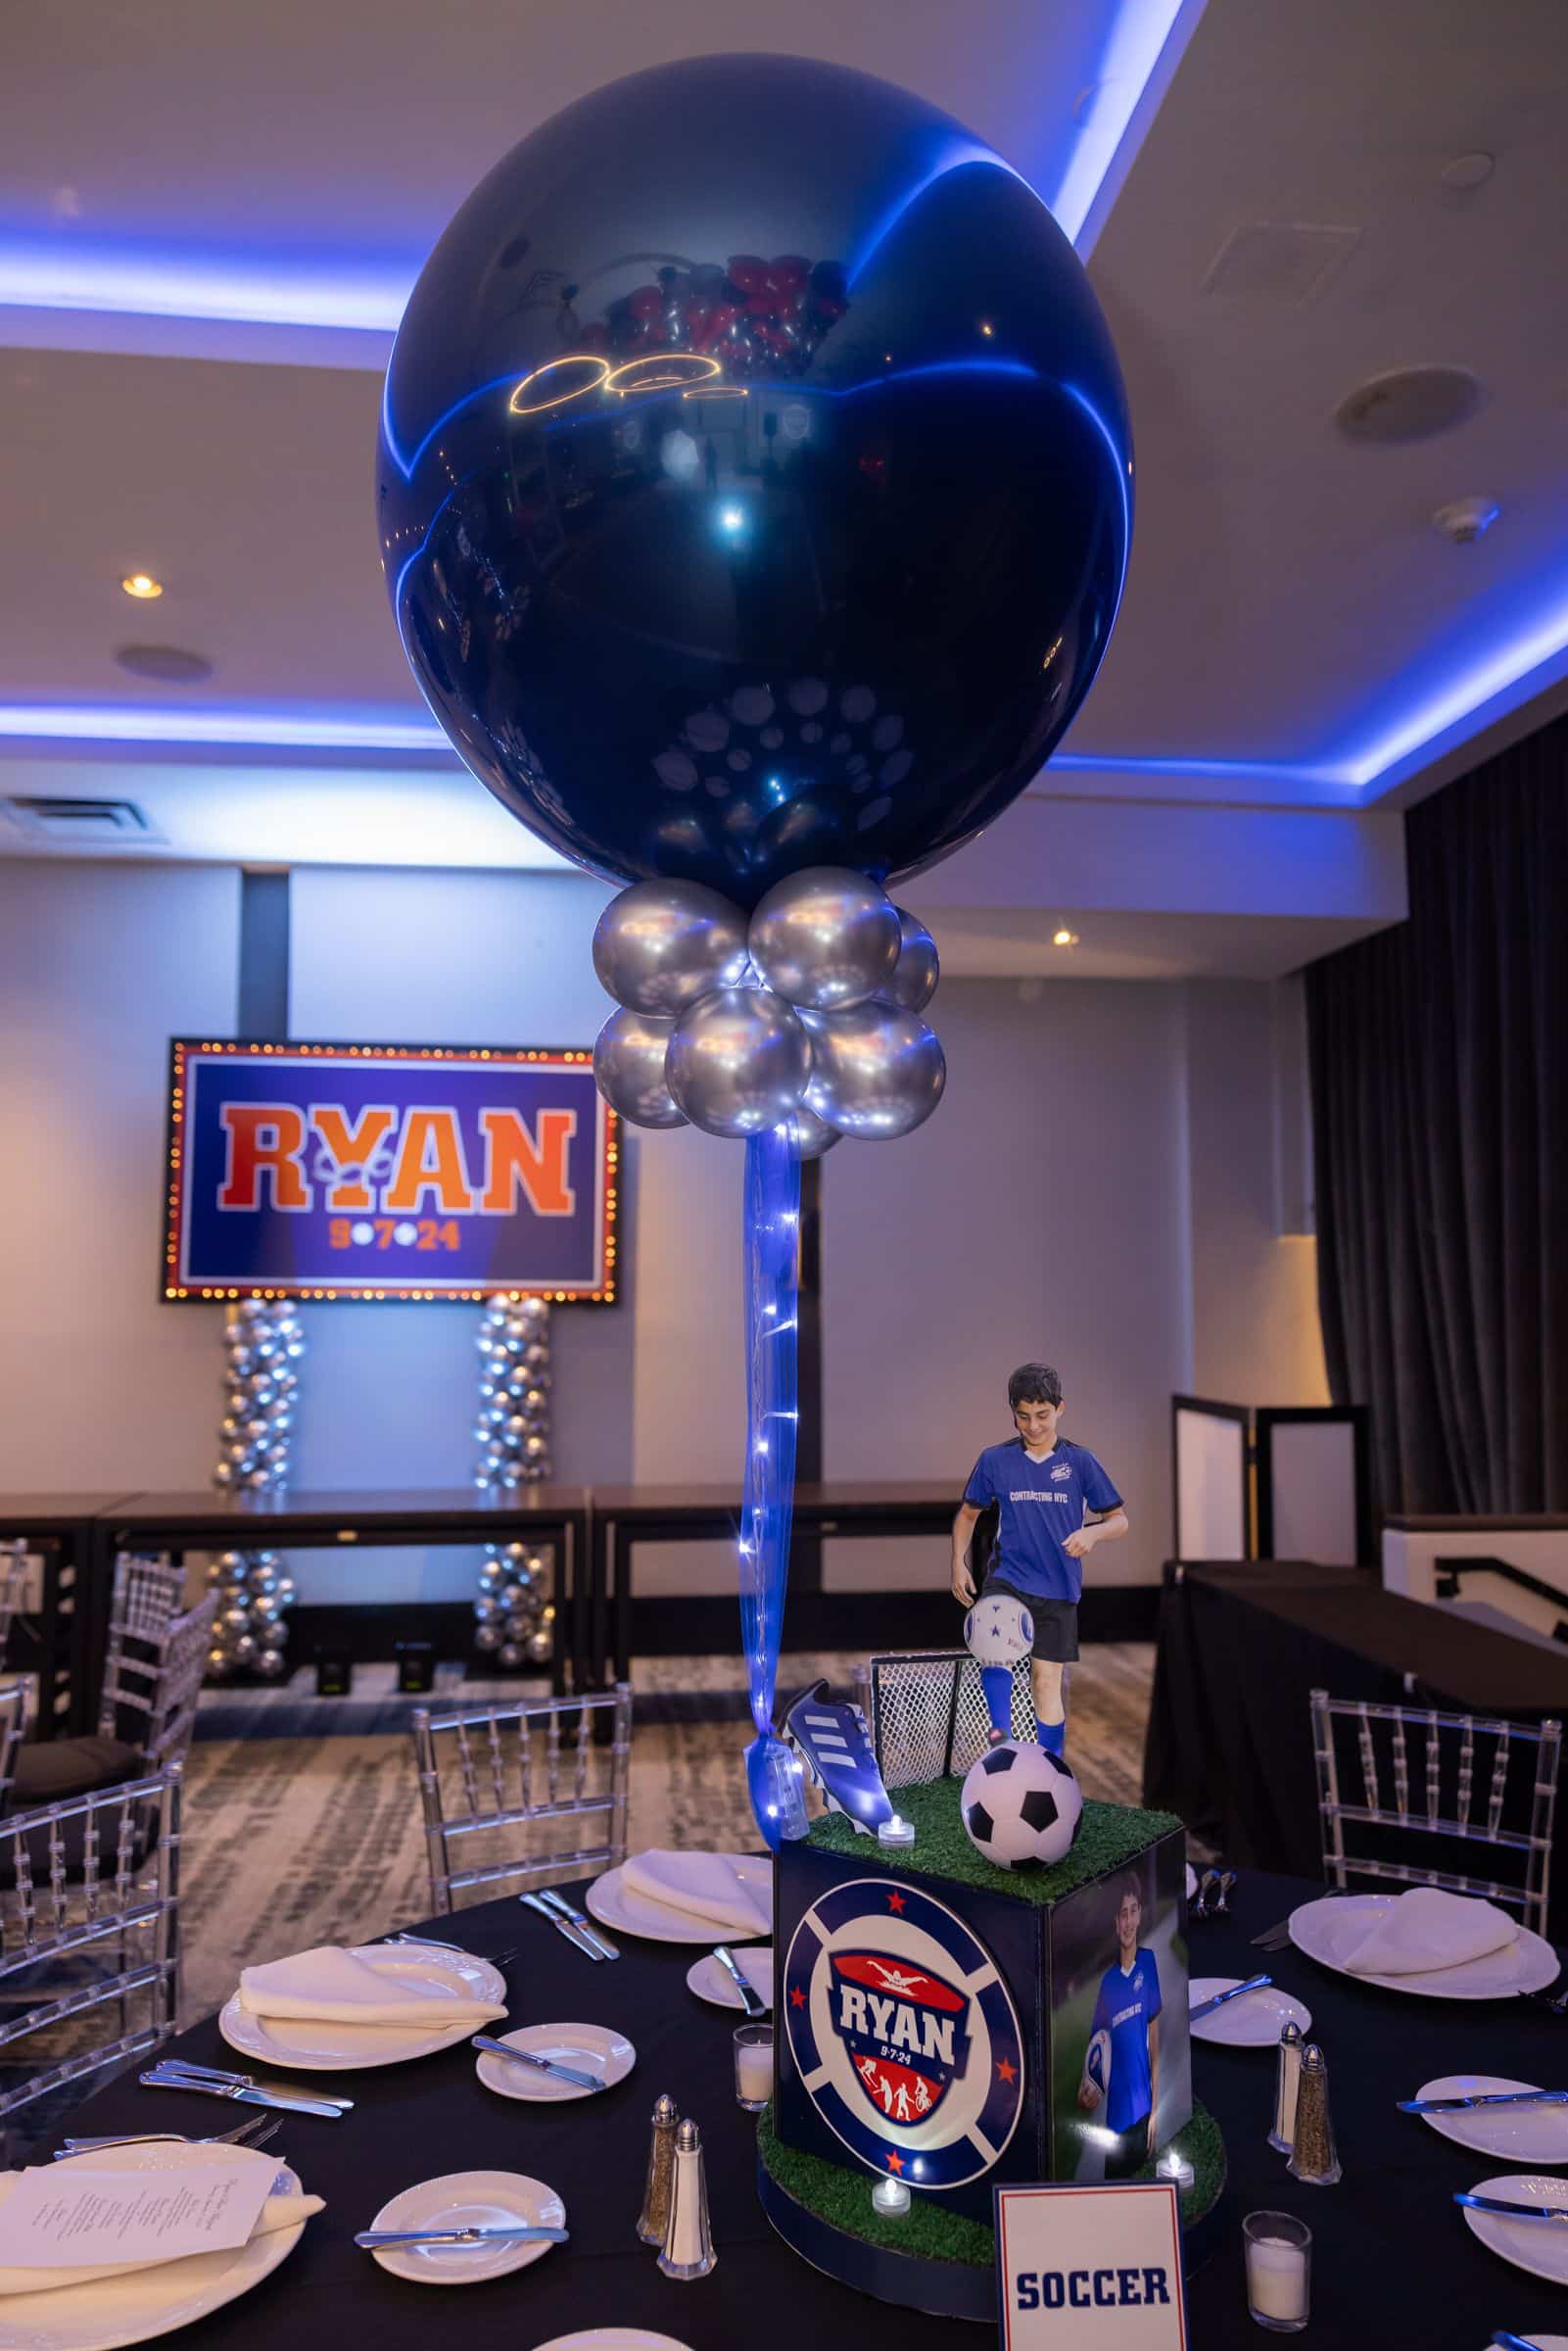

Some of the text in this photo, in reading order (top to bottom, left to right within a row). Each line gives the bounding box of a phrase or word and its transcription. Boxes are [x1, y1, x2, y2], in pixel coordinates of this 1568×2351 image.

[217, 1102, 577, 1215] RYAN
[840, 1984, 955, 2066] RYAN
[1017, 2268, 1170, 2311] SOCCER
